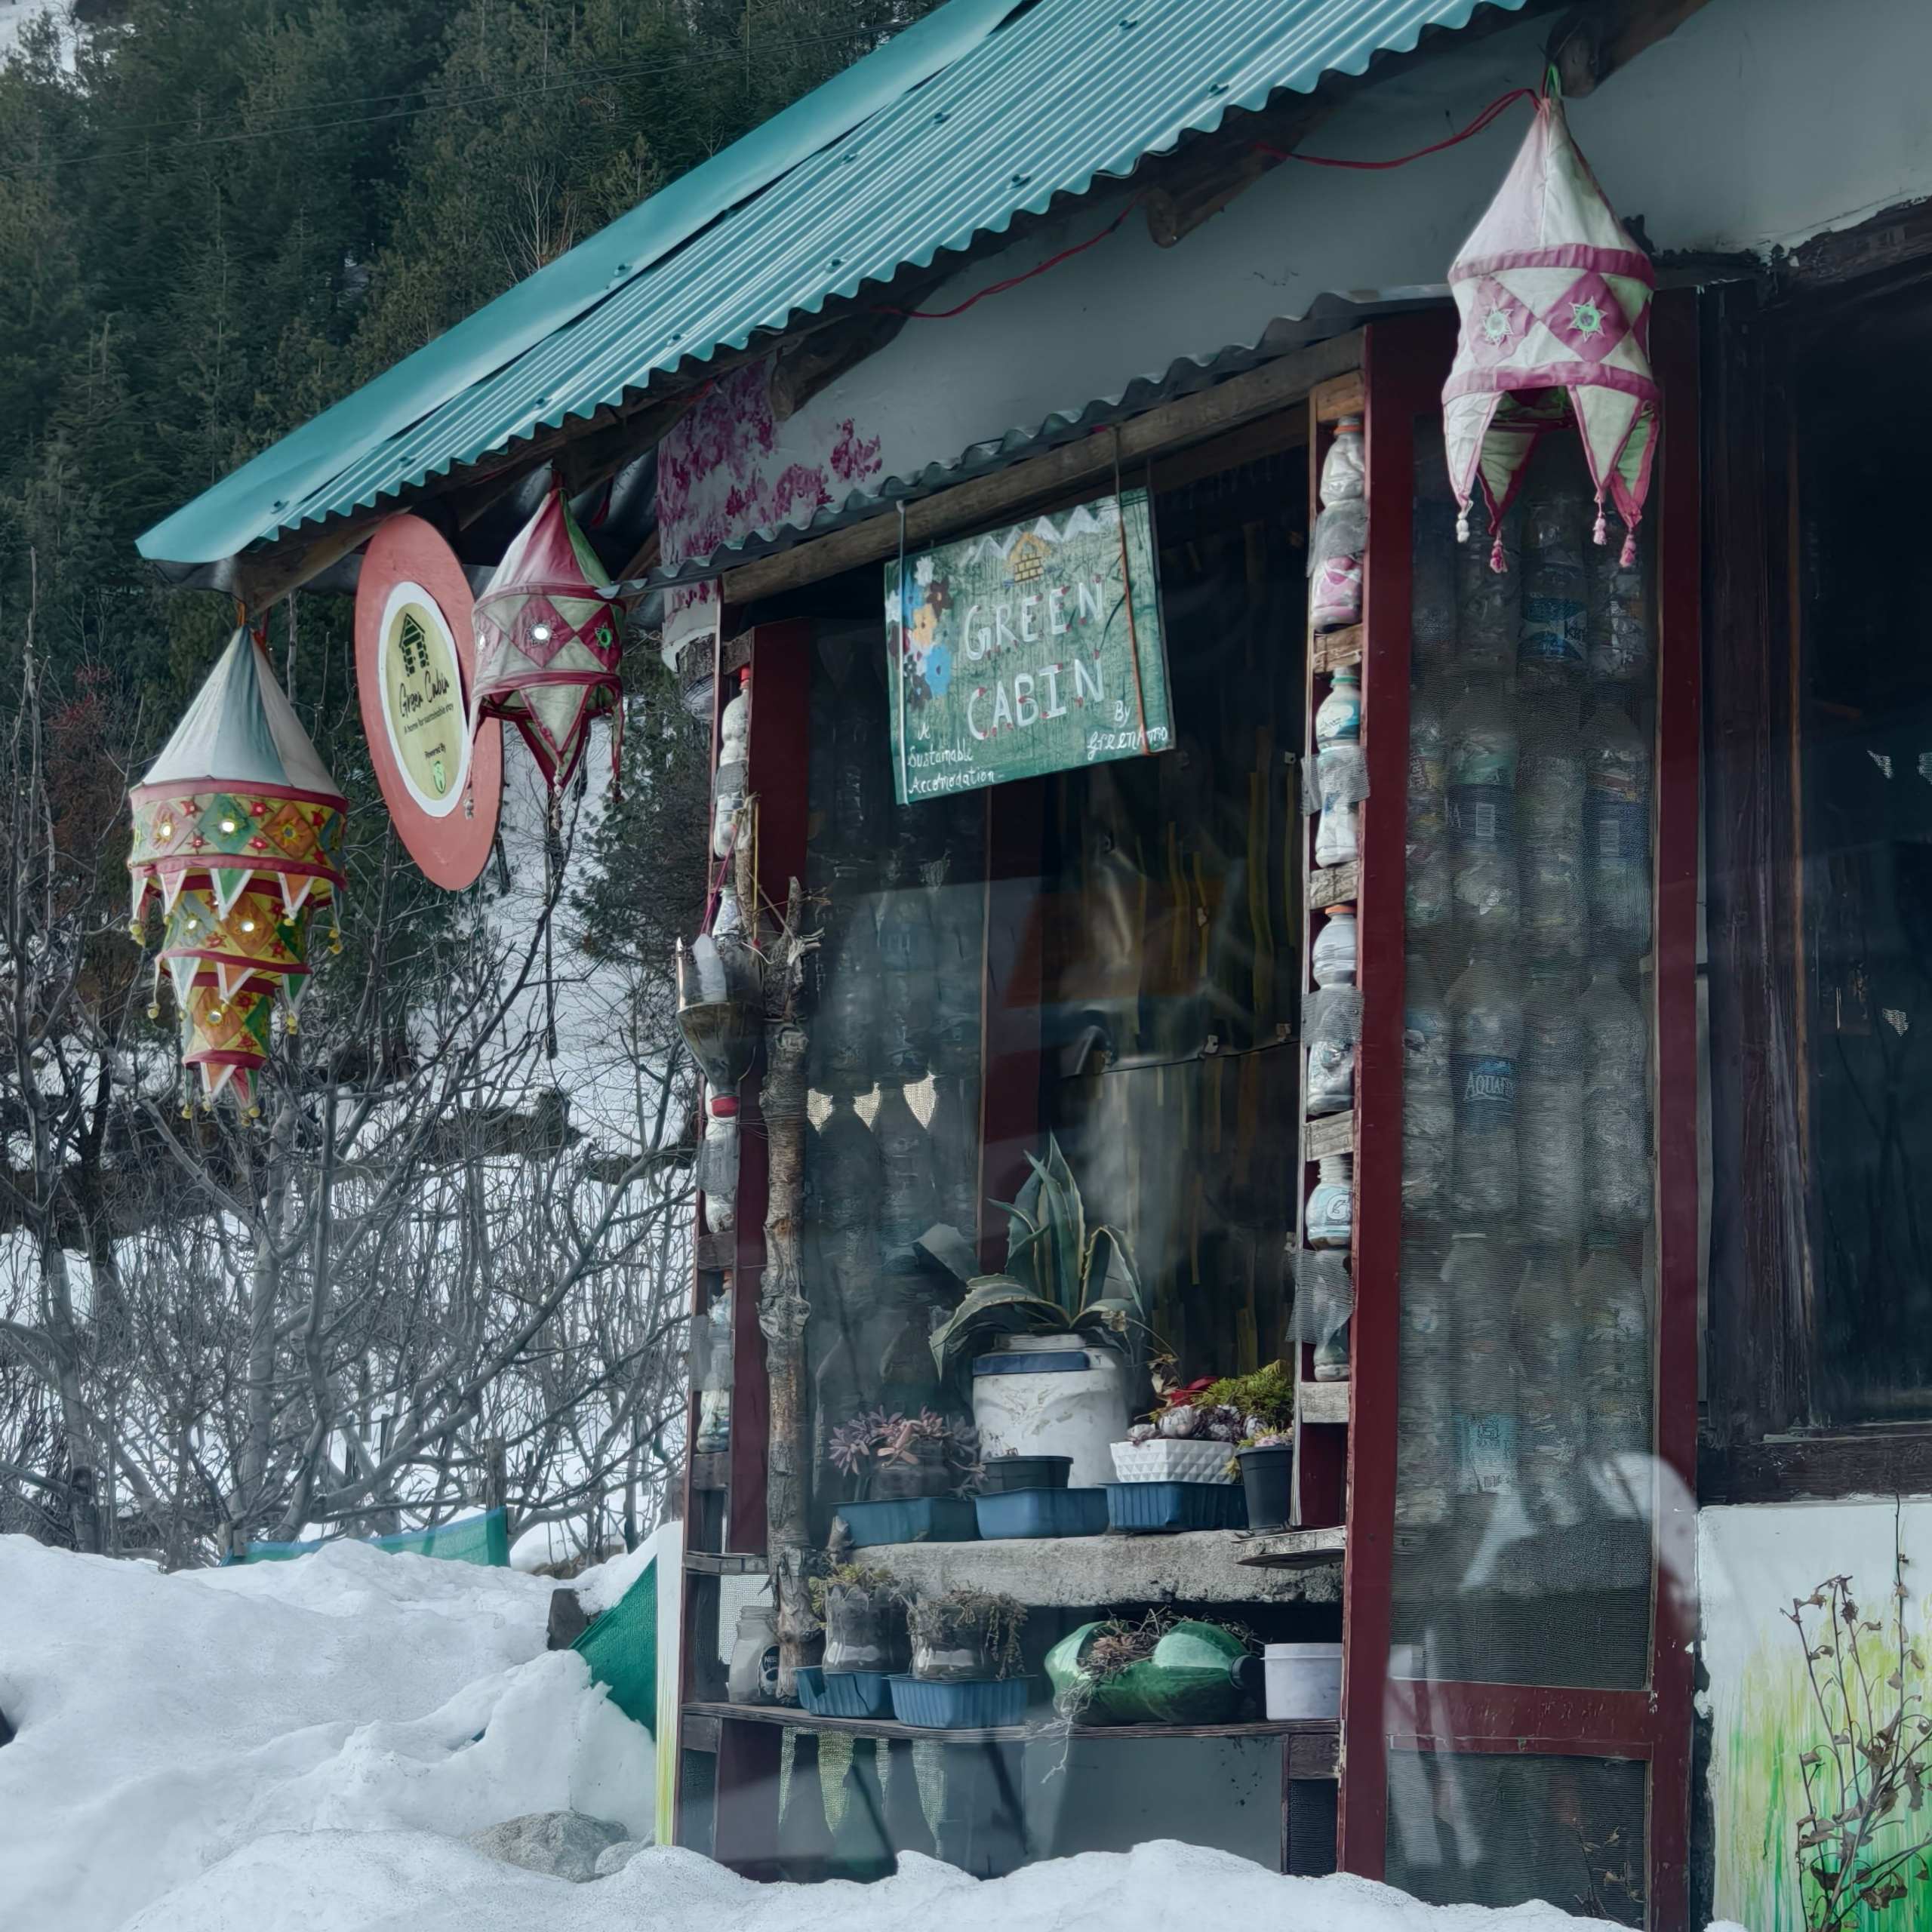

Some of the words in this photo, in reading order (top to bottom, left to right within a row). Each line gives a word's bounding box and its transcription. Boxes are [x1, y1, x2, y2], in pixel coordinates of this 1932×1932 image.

[964, 574, 1104, 661] GREEN
[398, 682, 423, 718] Green
[424, 669, 450, 703] Cabin
[967, 648, 1105, 741] CABIN
[1114, 700, 1131, 729] By
